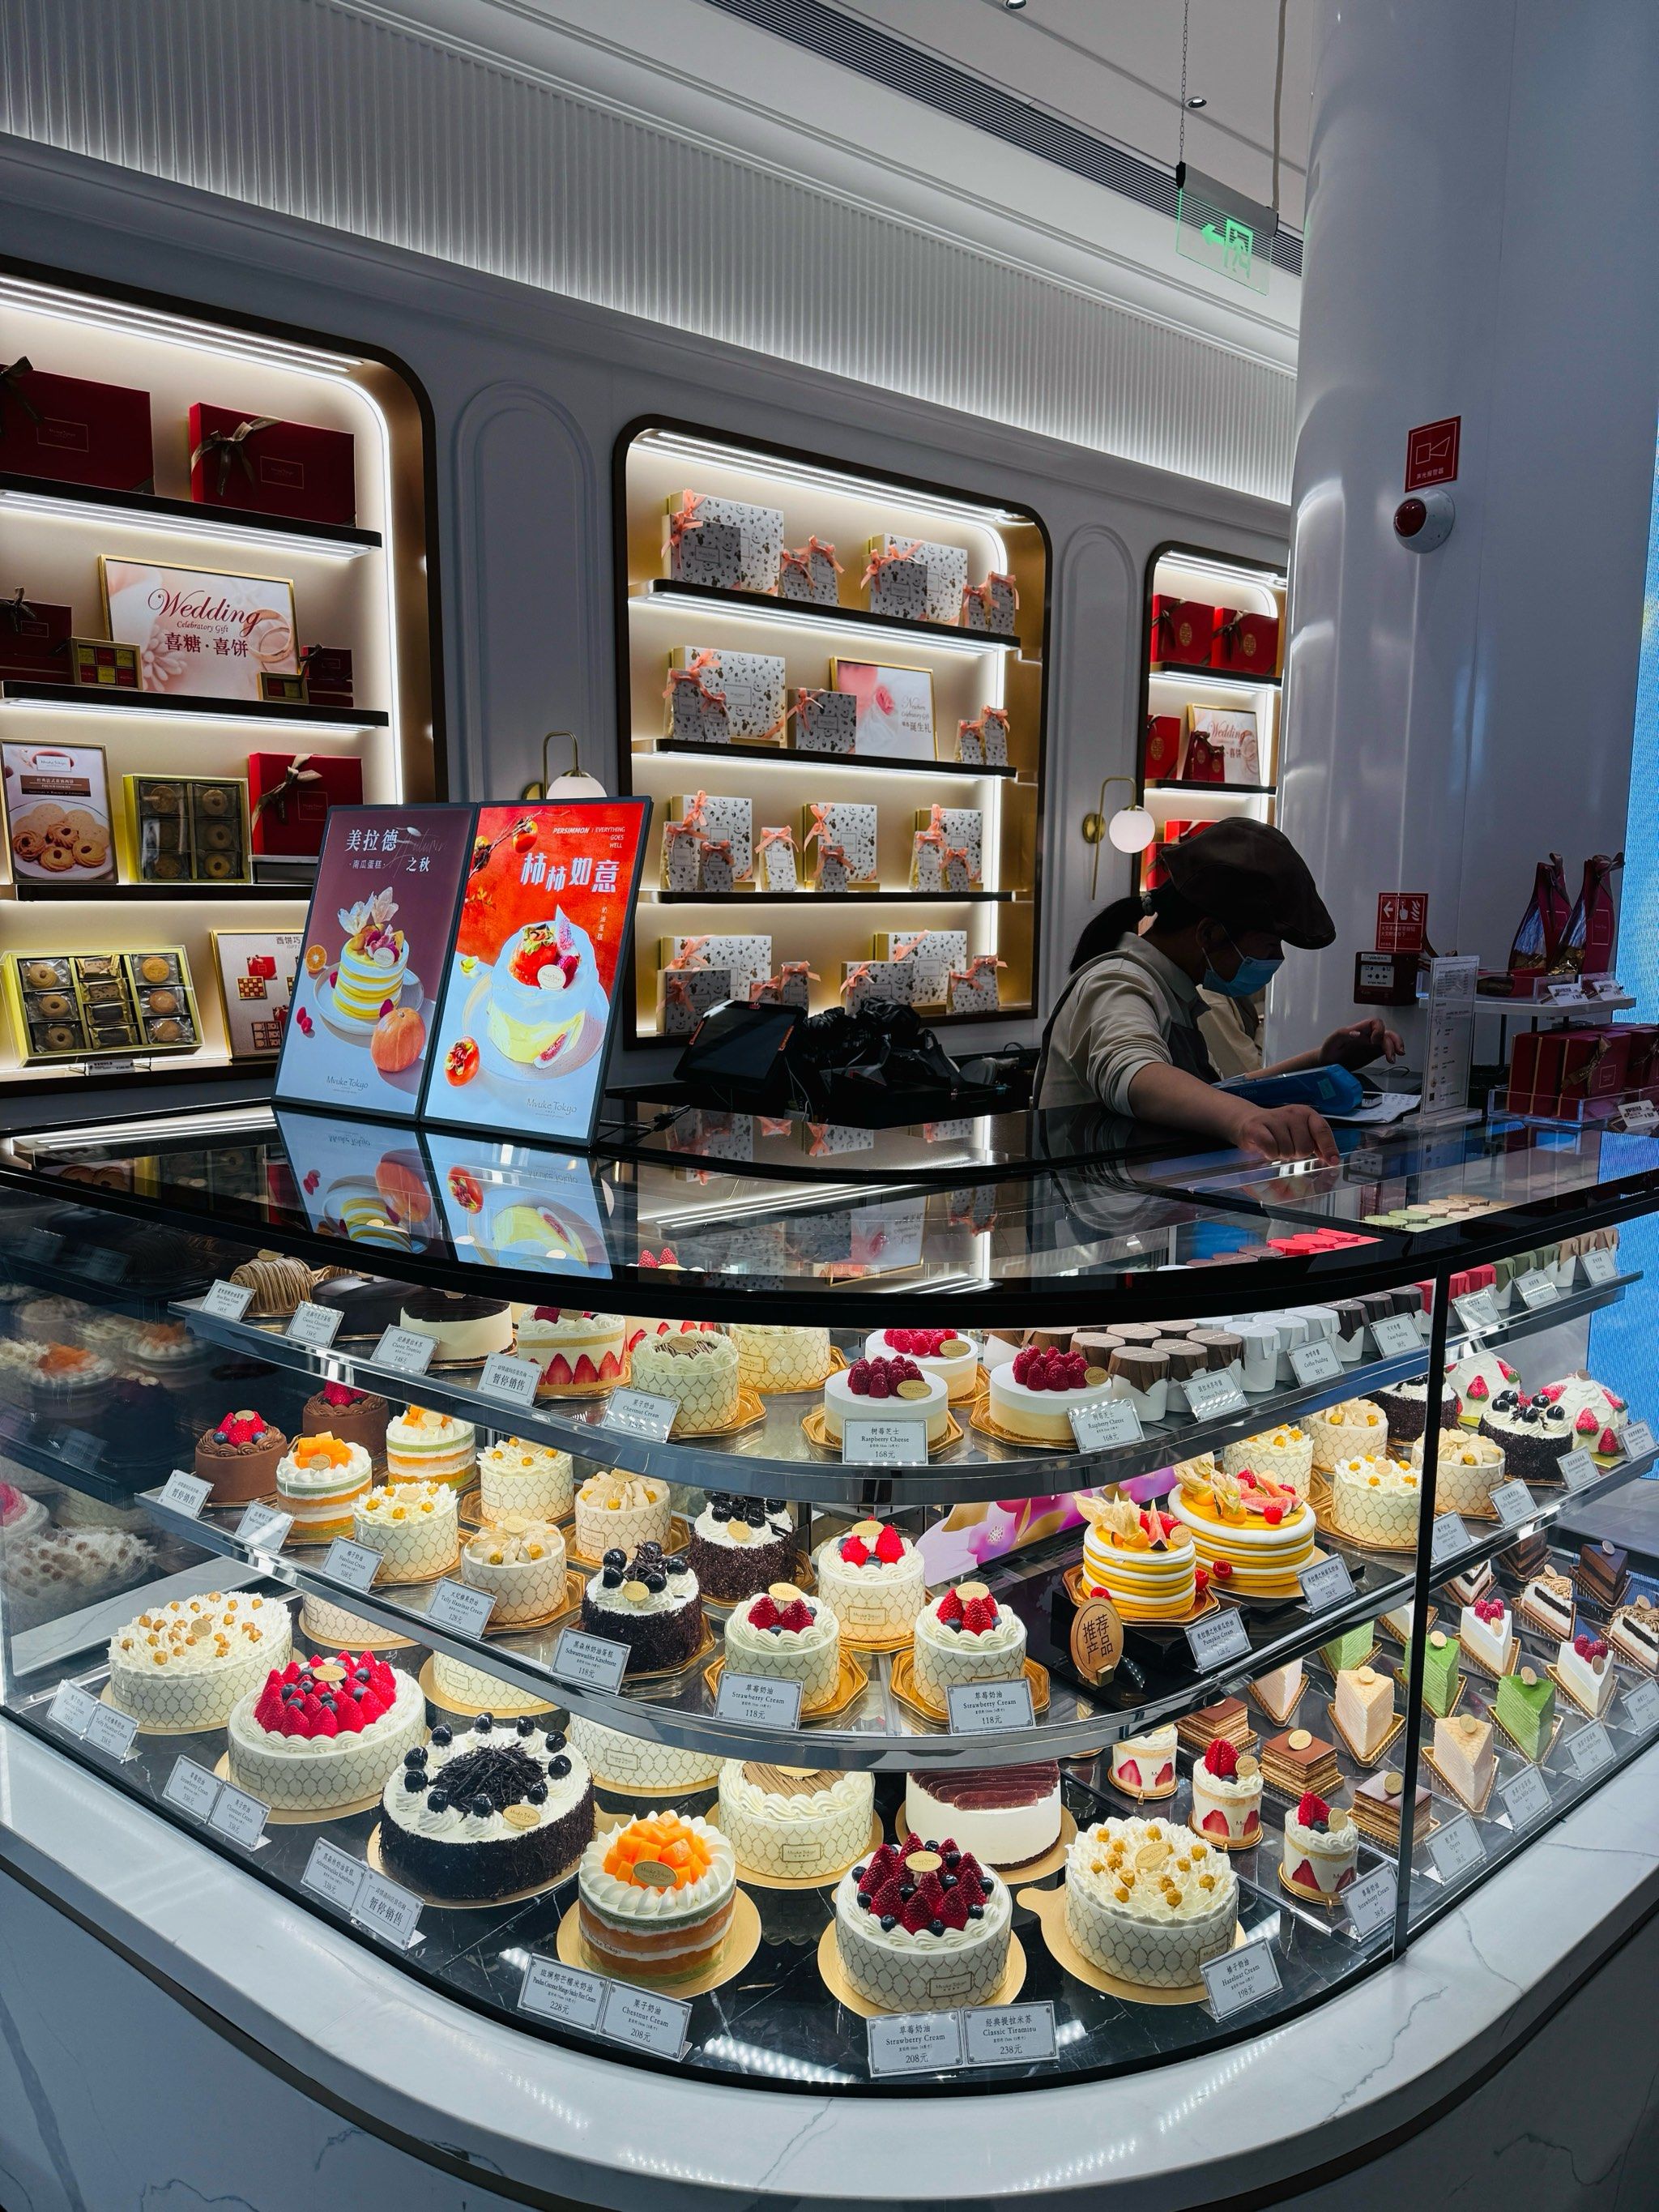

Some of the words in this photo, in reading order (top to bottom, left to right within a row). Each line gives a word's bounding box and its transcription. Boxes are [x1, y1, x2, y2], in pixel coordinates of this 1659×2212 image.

[148, 588, 262, 637] Wedding
[177, 621, 214, 632] Celebratory
[1208, 720, 1244, 745] Wedding
[552, 826, 590, 835] PERSIMMON
[344, 829, 399, 852] 美拉德
[406, 856, 431, 872] 之秋
[520, 852, 620, 893] 柿柿如意
[326, 1076, 348, 1085] Mvuke
[348, 1078, 369, 1090] Tokyo
[527, 1098, 552, 1109] Mvuke
[552, 1101, 578, 1116] Tokyo
[493, 1373, 526, 1391] 暂停销售
[871, 1427, 899, 1435] 树莓芝士
[1088, 1420, 1109, 1429] Raspberry
[1102, 1433, 1120, 1442] 168元
[875, 1450, 896, 1458] 168元
[171, 1488, 197, 1506] 暂停销售
[1203, 1634, 1221, 1646] Pumpkin
[573, 1640, 613, 1658] 黑森林奶油蛋糕
[578, 1667, 595, 1679] 118元
[745, 1684, 774, 1695] 草莓奶油
[975, 1690, 1003, 1700] 草莓奶油
[731, 1692, 764, 1703] Strawberry
[765, 1696, 785, 1704] Cream
[963, 1701, 996, 1709] Strawberry
[745, 1710, 766, 1719] 118元
[982, 1715, 1003, 1724] 118元
[1358, 1894, 1379, 1911] Strawberry
[1377, 1885, 1390, 1897] Cream
[368, 1896, 404, 1927] 暂停销售
[1375, 1907, 1387, 1919] 38元
[1226, 1958, 1250, 1975] 榛子奶油
[540, 1968, 594, 1994] 斑斓椰芒糯米奶油
[1222, 1972, 1244, 1987] Hazelnut
[1243, 1964, 1260, 1975] Cream
[1238, 1984, 1256, 1999] 198元
[549, 2001, 570, 2016] 228元
[633, 1997, 662, 2015] 栗子奶油
[621, 2005, 649, 2021] Chestnut
[649, 2014, 669, 2028] Cream
[985, 2014, 1032, 2027] 经典提拉米苏
[630, 2028, 651, 2043] 208元
[898, 2025, 931, 2035] 草莓奶油
[983, 2027, 1006, 2037] Classic
[1007, 2026, 1037, 2035] Tiramisu
[885, 2035, 923, 2046] Strawberry
[923, 2034, 945, 2042] Cream
[1000, 2044, 1023, 2055] 238元
[905, 2053, 929, 2064] 208元
